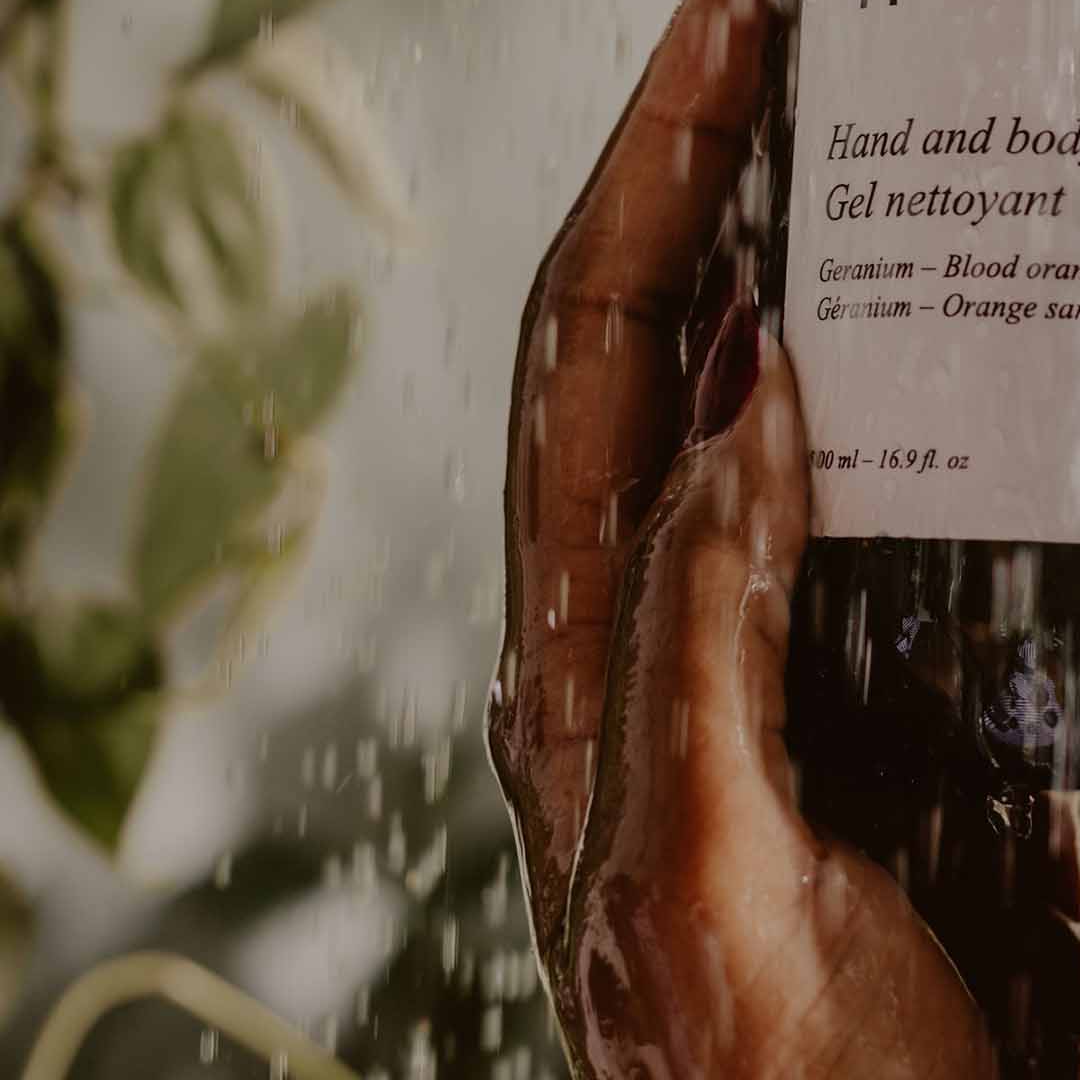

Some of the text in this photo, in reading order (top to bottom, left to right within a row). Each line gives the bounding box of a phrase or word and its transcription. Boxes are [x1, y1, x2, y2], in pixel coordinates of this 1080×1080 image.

[827, 118, 915, 160] Hand
[922, 117, 997, 156] and
[825, 180, 1066, 226] Gel nettoyant
[819, 256, 915, 282] Geranium
[943, 253, 1021, 280] Blood
[816, 295, 913, 321] Géranium
[942, 292, 1038, 325] Orange
[838, 448, 860, 469] ml
[879, 448, 918, 469] 16.9
[917, 448, 940, 474] fl.
[947, 454, 970, 470] oz
